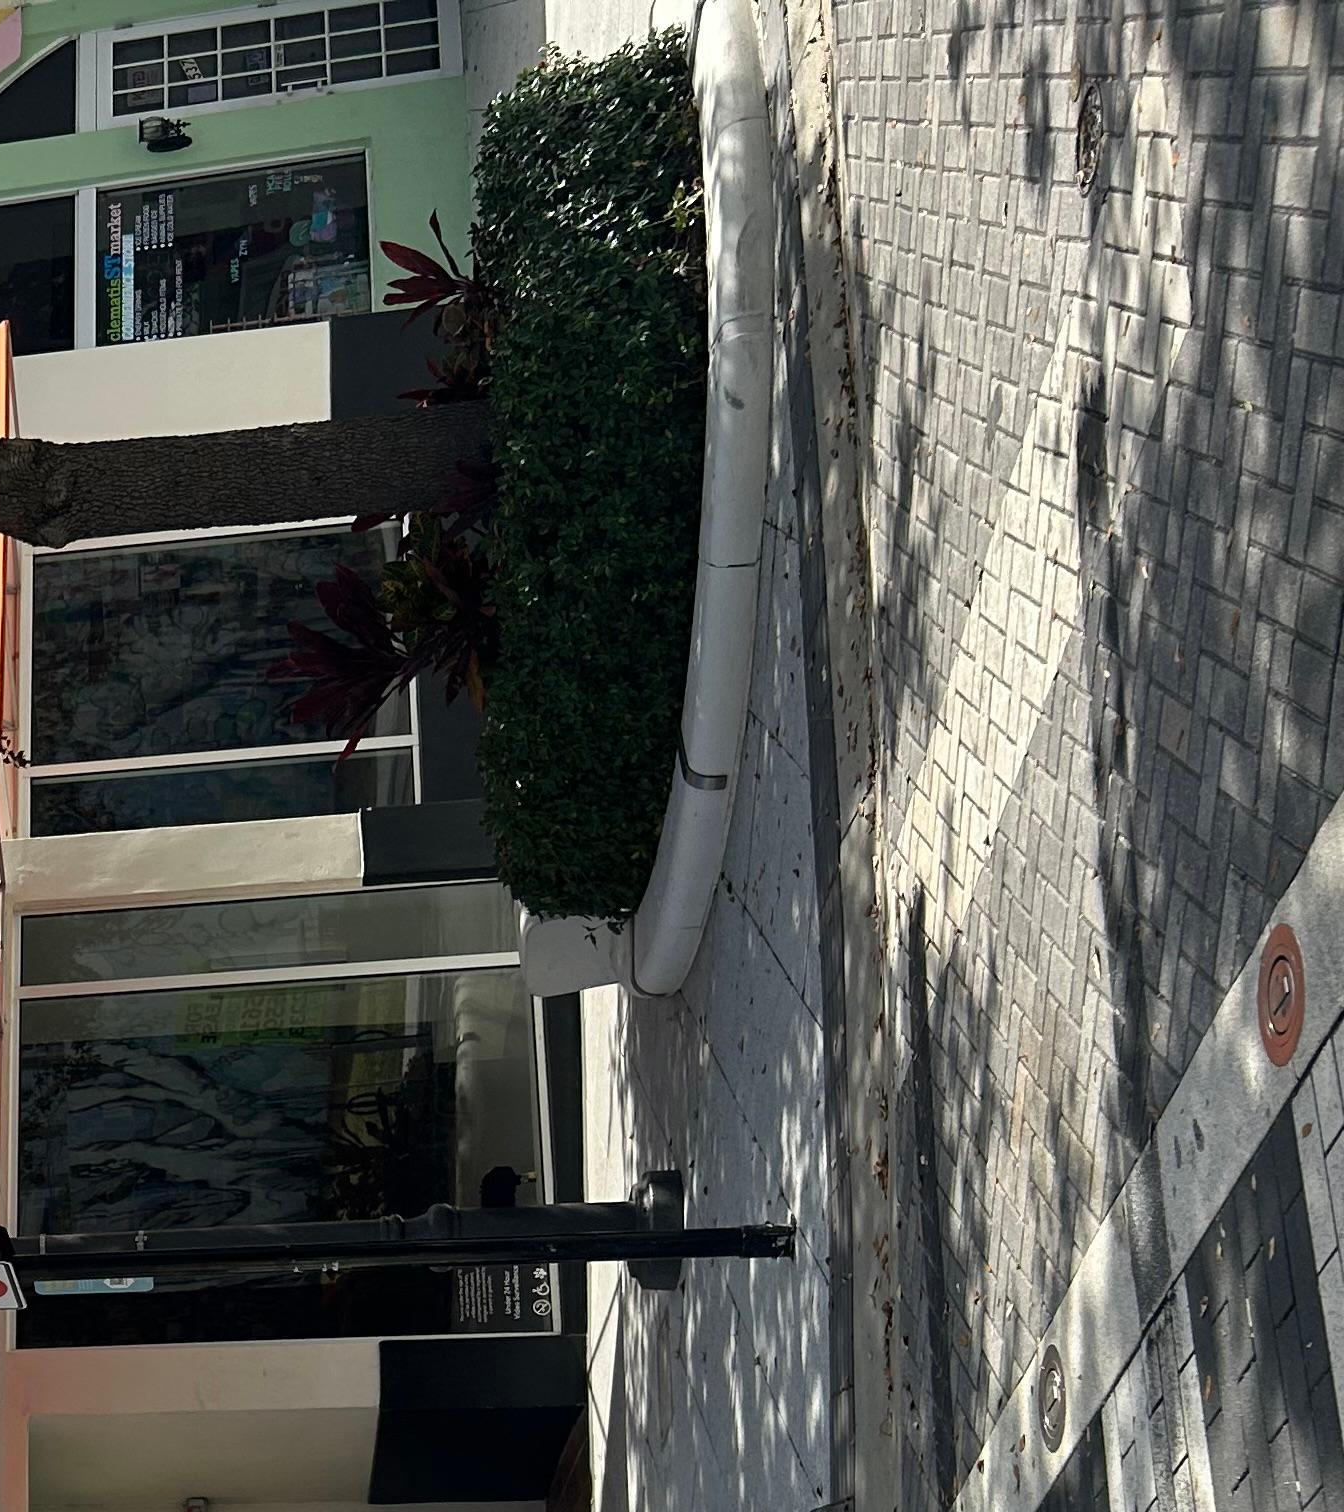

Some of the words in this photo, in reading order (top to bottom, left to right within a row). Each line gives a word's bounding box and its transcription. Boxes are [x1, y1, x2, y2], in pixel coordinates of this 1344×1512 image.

[180, 60, 202, 80] 537
[239, 240, 248, 256] ZYN
[230, 258, 240, 283] VAPES
[122, 274, 134, 340] CONVENIENCE
[504, 1296, 512, 1314] Under
